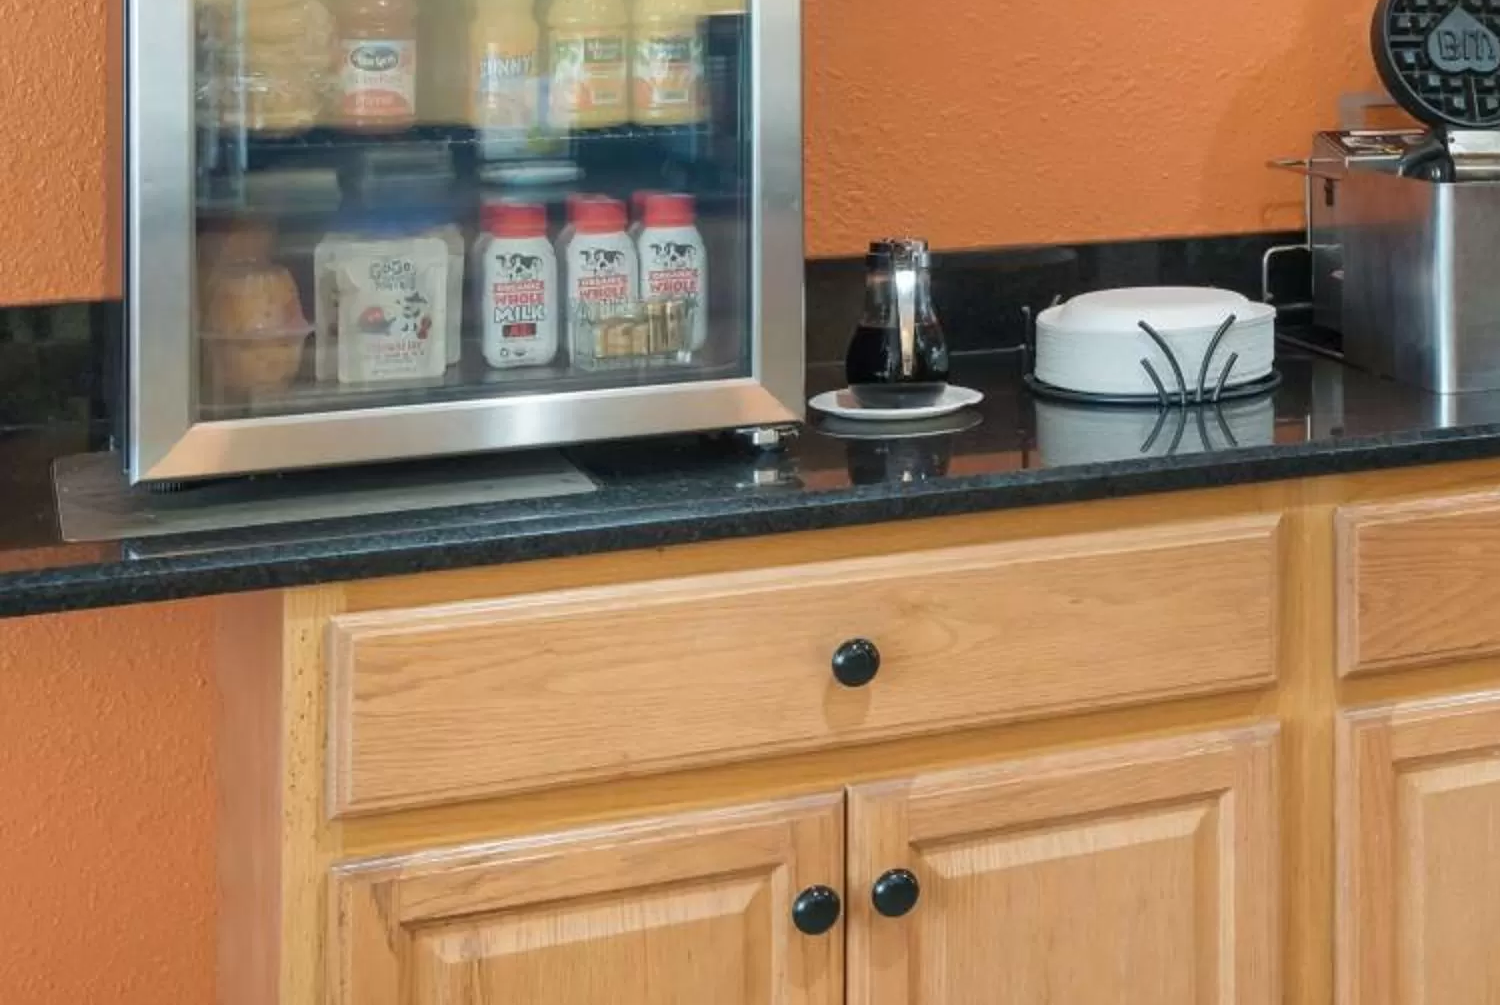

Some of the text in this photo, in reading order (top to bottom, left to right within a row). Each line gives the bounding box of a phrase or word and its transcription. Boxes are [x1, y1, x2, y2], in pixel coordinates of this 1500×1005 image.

[577, 285, 628, 299] WHOLE
[651, 279, 699, 293] WHOLE
[493, 292, 545, 305] WHOLE
[494, 305, 545, 323] MILK
